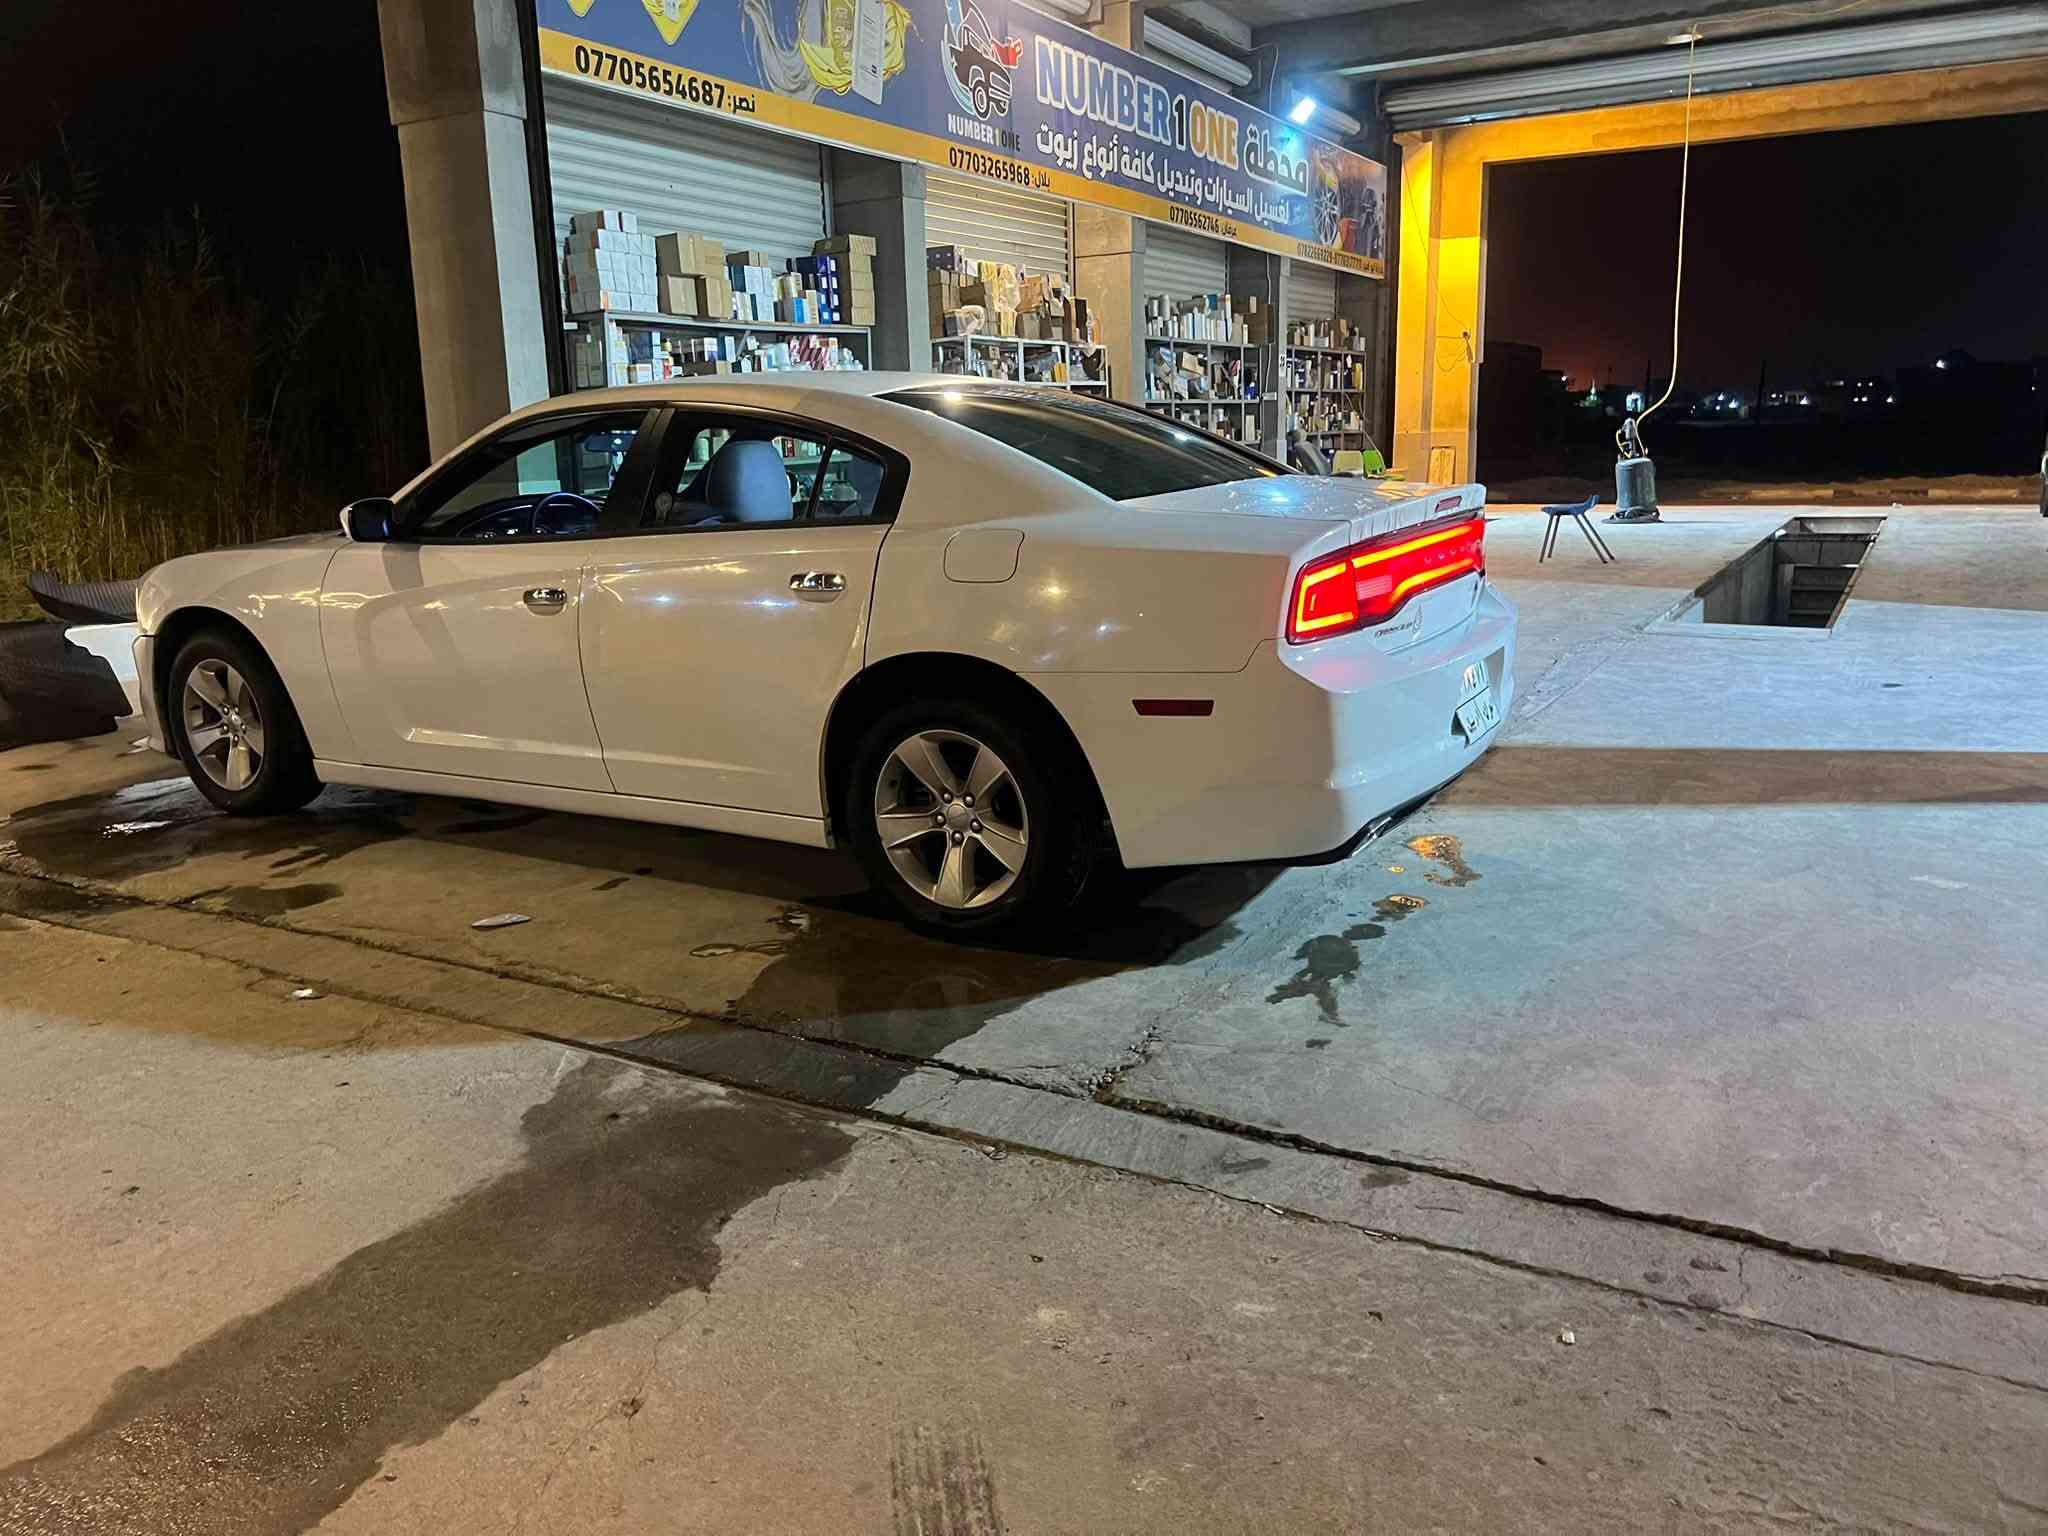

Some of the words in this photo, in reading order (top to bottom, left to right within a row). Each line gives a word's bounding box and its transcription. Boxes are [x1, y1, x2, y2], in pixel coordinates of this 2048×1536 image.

[575, 44, 726, 109] 07705654687
[1034, 33, 1171, 146] NUMBER
[1172, 93, 1187, 151] 1
[1188, 100, 1239, 171] ONE
[947, 112, 994, 146] NUMBER
[994, 126, 1001, 147] 1
[1001, 129, 1021, 153] ONE
[1036, 120, 1079, 171] زيوت
[949, 146, 1030, 186] 07703265968
[1081, 133, 1119, 180] أنواع
[1120, 145, 1156, 185] كافة
[1243, 123, 1309, 197] محطة
[1204, 175, 1254, 216] السيارات
